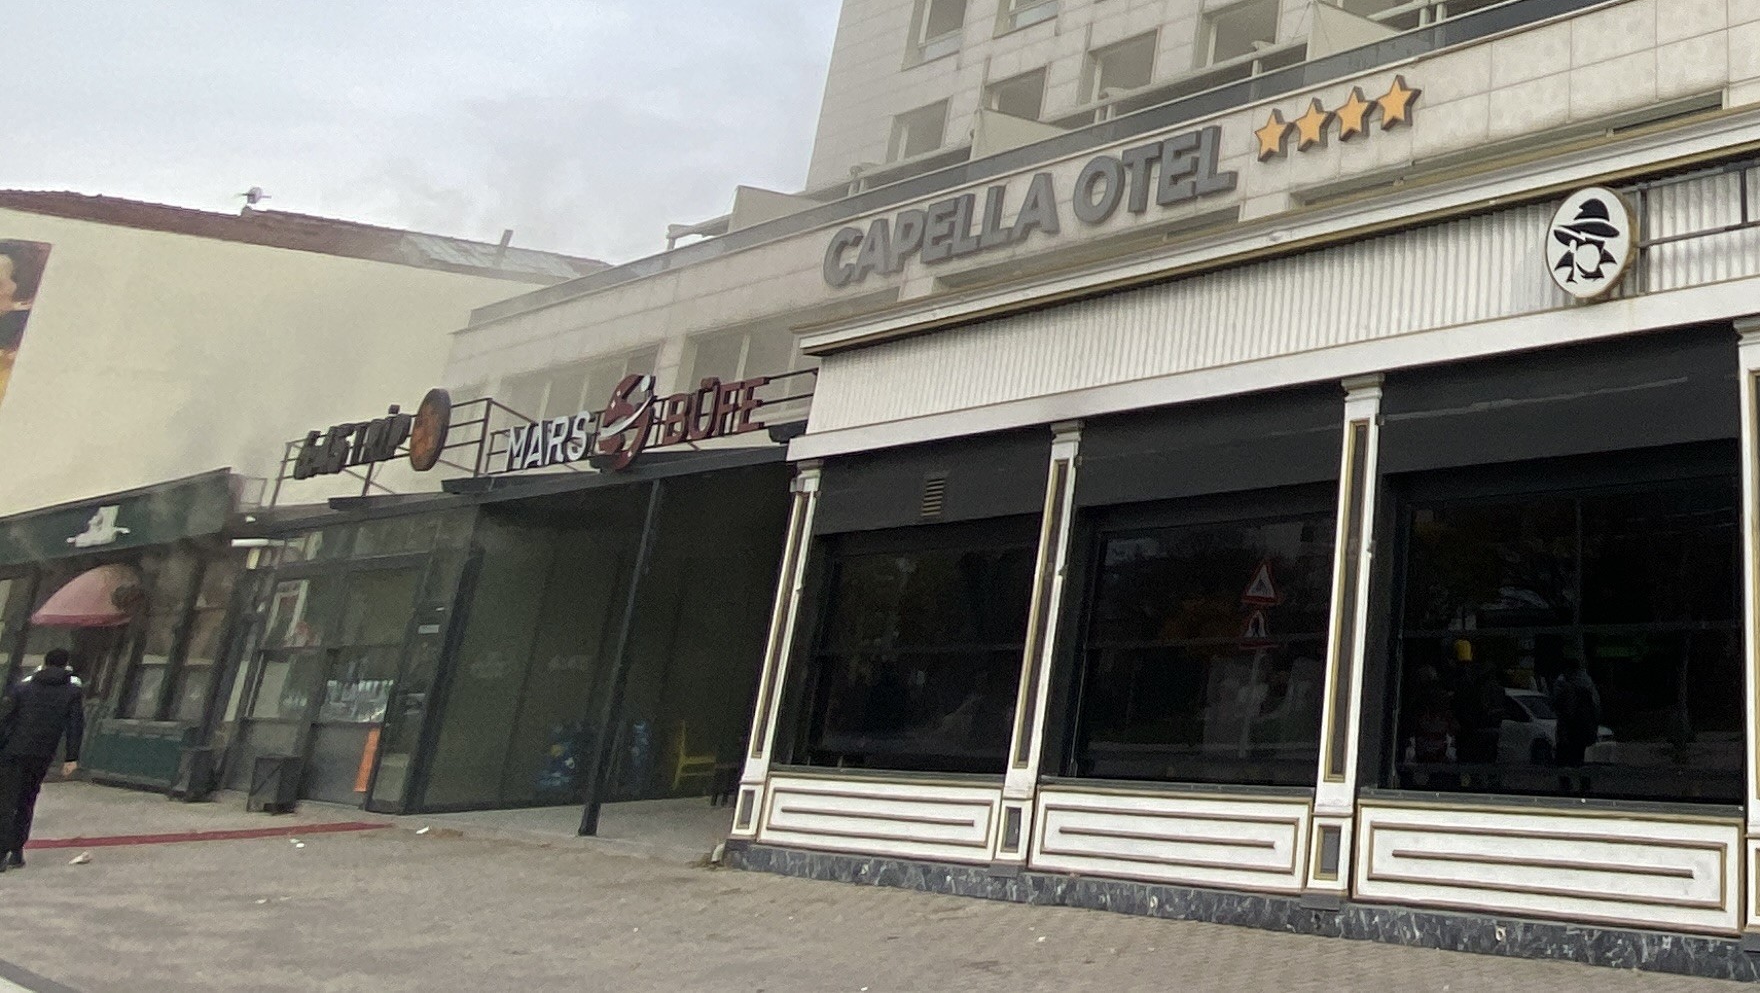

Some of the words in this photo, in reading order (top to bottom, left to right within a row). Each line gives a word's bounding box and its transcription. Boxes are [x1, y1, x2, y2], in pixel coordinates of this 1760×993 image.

[822, 172, 1060, 288] CAPELLA
[1072, 124, 1239, 224] OTEL
[504, 410, 595, 472] MARS
